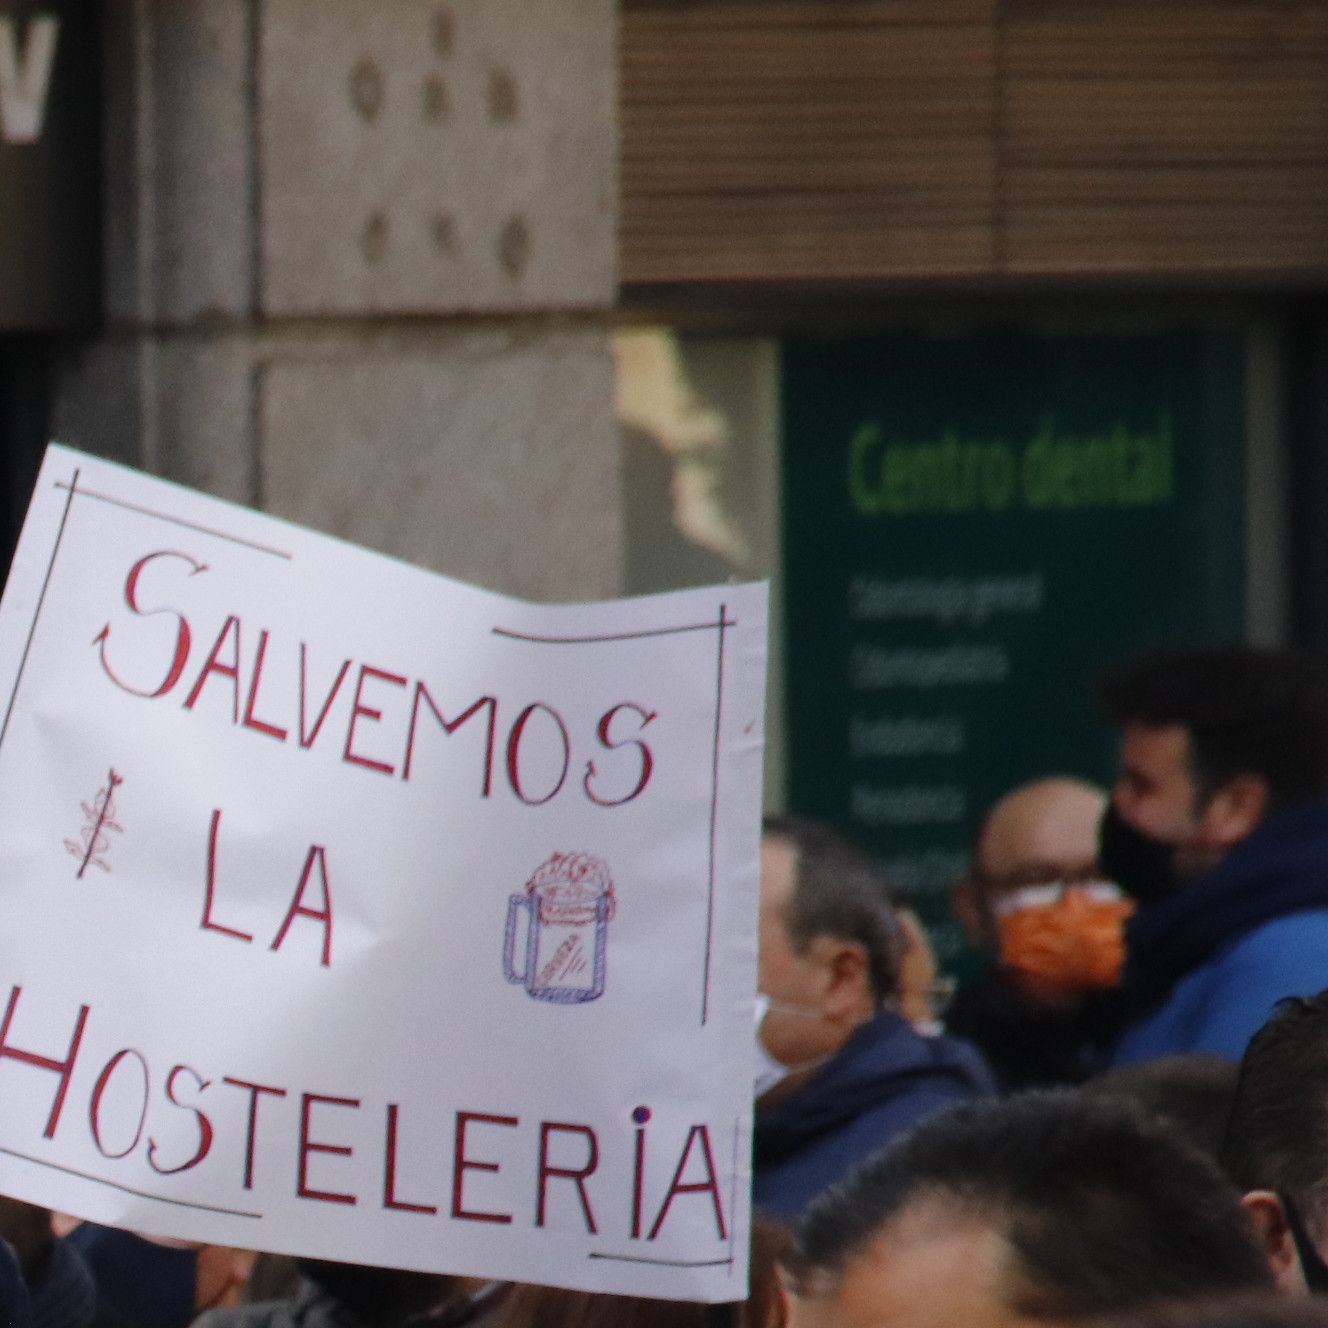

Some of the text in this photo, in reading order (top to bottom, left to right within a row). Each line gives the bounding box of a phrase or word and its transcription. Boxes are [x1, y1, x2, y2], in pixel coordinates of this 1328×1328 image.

[848, 408, 1175, 515] Centro dental
[92, 550, 659, 807] SALVEMOS
[199, 808, 337, 968] LA
